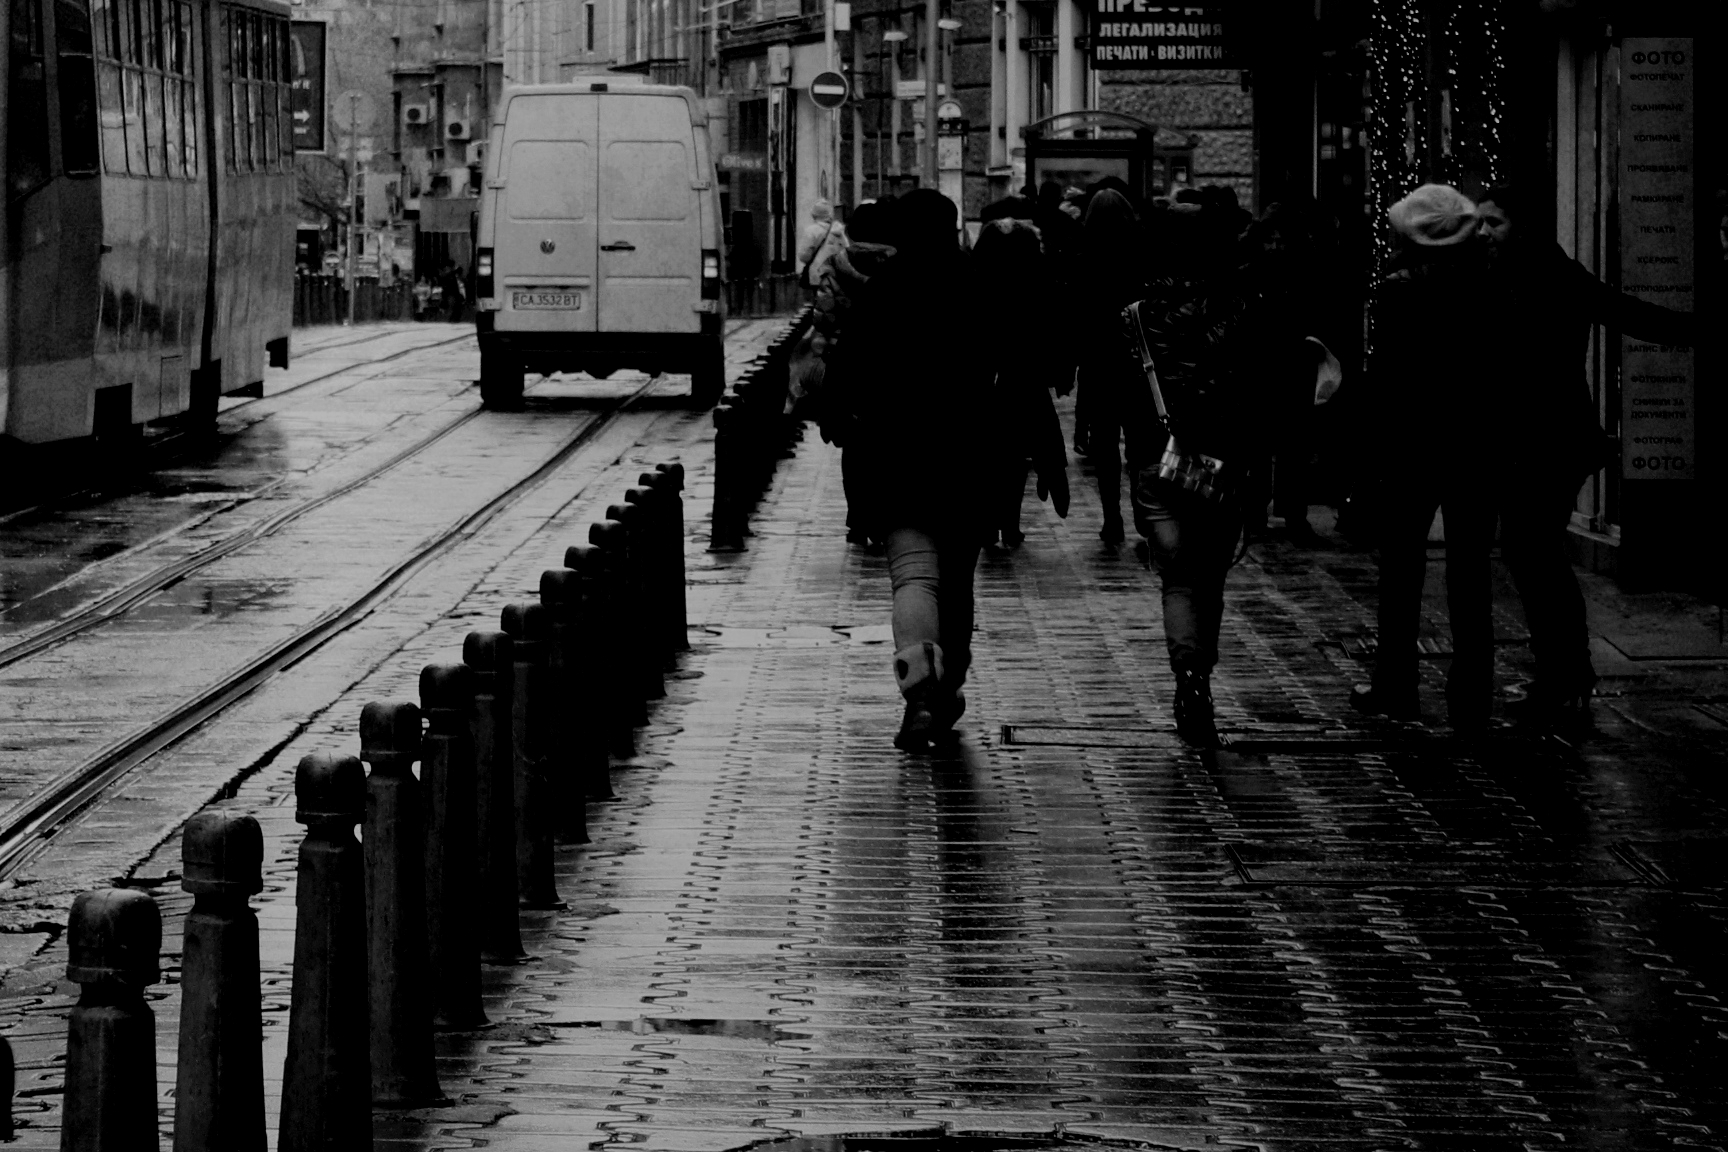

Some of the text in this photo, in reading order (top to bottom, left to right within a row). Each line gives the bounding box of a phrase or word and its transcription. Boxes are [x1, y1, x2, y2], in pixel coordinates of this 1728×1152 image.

[1098, 21, 1223, 38] ЛЕГАЛИЗАЦИЯ
[1095, 44, 1223, 61] ПЕЧАТИ ВИЗИТКИ
[1631, 50, 1685, 65] ФОТО
[1629, 73, 1685, 81] ФОТОПЕЧАТ
[1630, 103, 1685, 112] СКАНИРАНЕ
[1633, 134, 1681, 143] КОПИРАНЕ
[1631, 195, 1685, 203] РАМКИРАНЕ
[1640, 225, 1676, 234] ПЕЧАТИ
[1637, 256, 1679, 265] КСЕРОКС
[1672, 398, 1685, 406] ЗА
[1630, 410, 1687, 419] ДОКУМЕНТИ
[1633, 436, 1684, 445] ФОТОГРАФ
[1631, 456, 1686, 471] ФОТО
